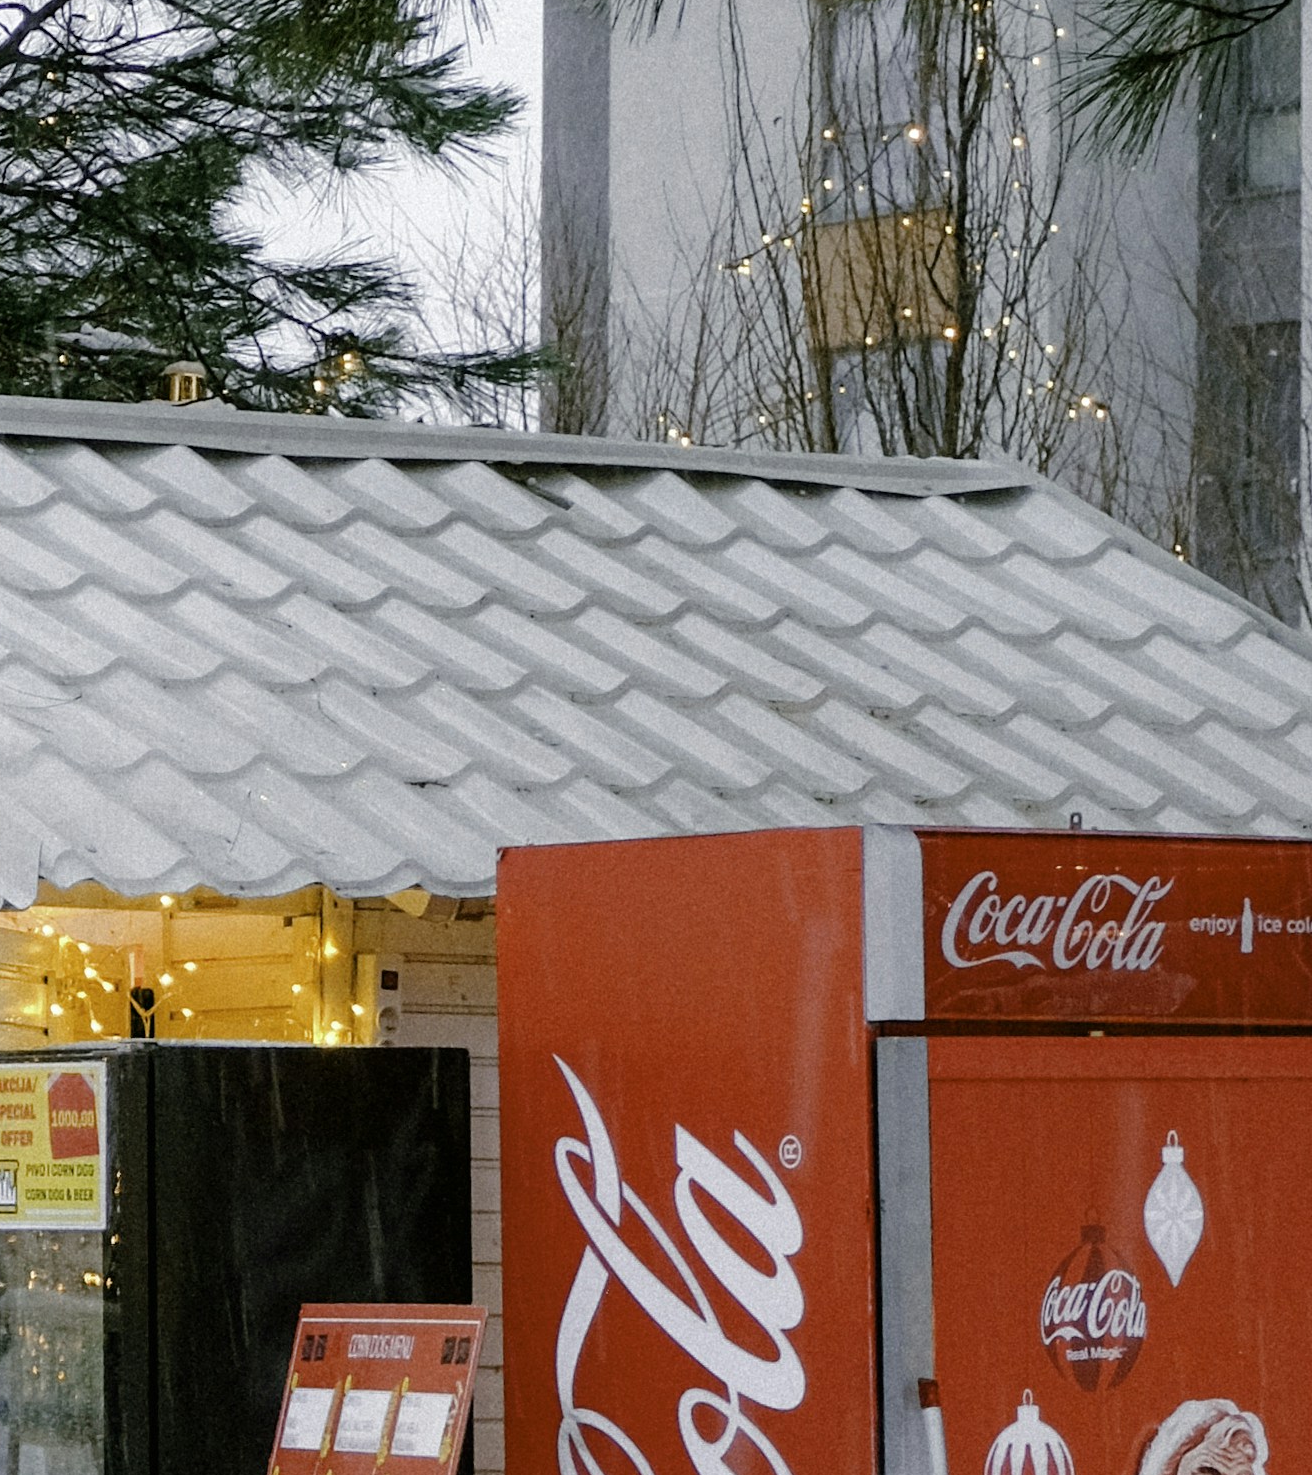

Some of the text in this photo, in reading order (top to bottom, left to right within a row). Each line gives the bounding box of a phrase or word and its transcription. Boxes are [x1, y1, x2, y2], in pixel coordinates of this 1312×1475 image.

[941, 870, 1175, 971] Coca-Cola
[1189, 914, 1312, 937] enjoy ice col
[0, 1130, 34, 1148] OFFER
[1041, 1269, 1147, 1345] Coca-Cola
